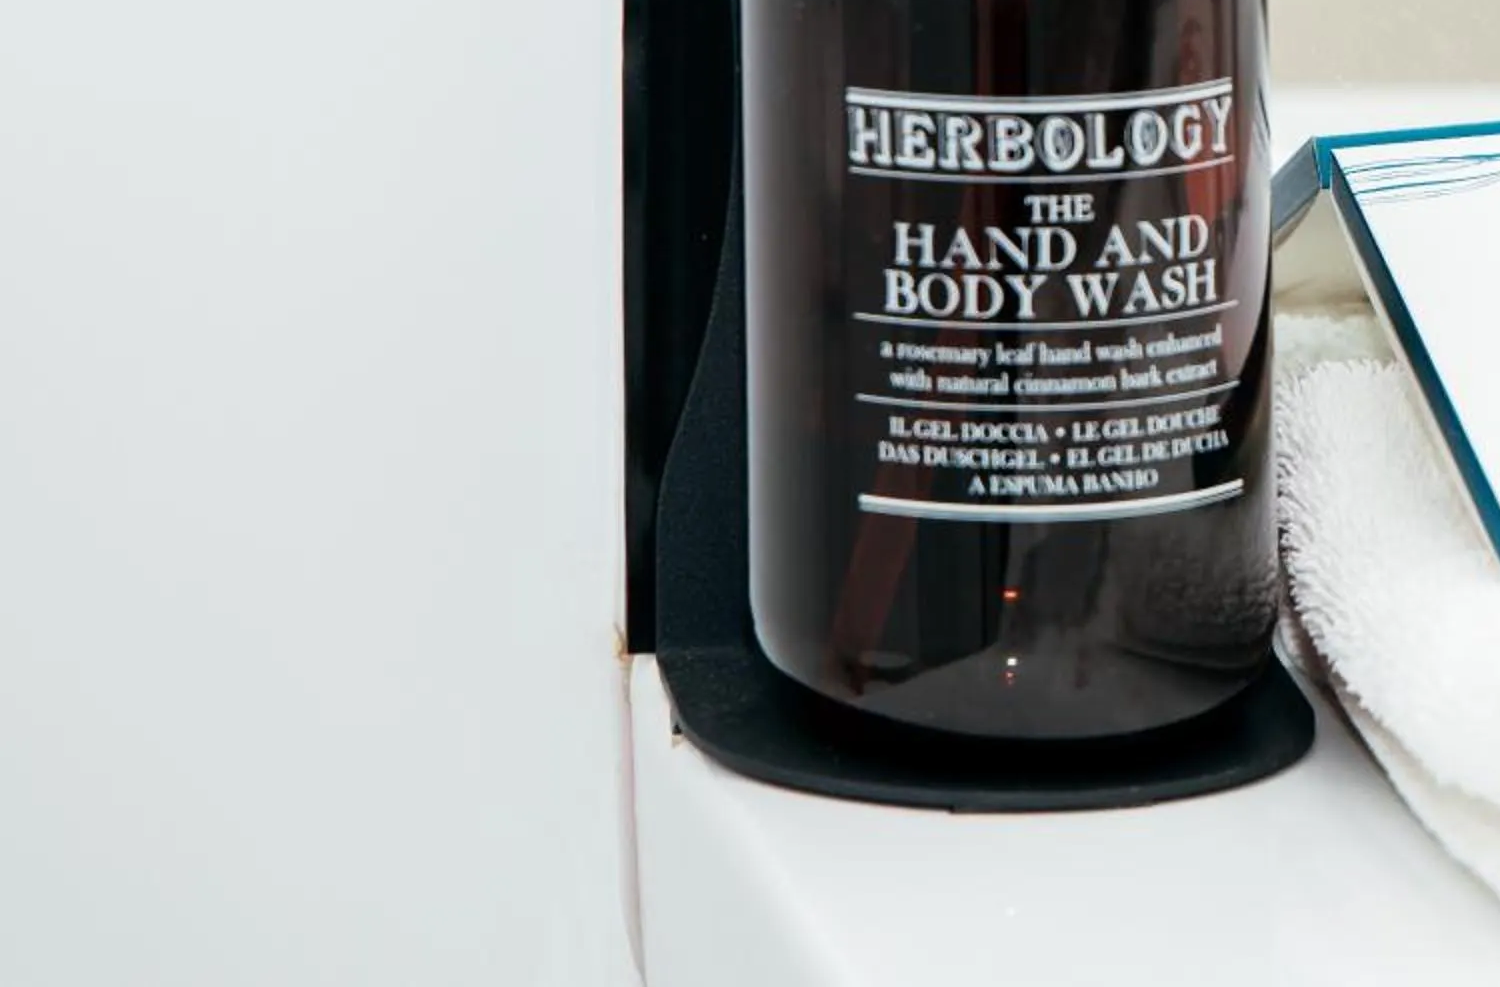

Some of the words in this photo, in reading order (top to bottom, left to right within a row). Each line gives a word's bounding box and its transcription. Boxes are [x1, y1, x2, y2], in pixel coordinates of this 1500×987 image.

[847, 96, 1232, 173] HERBOLOGY
[1024, 193, 1095, 224] THE
[893, 221, 1077, 270] HAND
[1094, 213, 1209, 268] AND
[884, 268, 1046, 319] BODY
[1066, 259, 1217, 318] WASH
[880, 341, 893, 358] a
[896, 342, 992, 369] rosemary
[995, 341, 1035, 366] leaf
[1038, 340, 1092, 365] hand
[1095, 336, 1143, 362] wash
[1146, 322, 1222, 358] enhanced
[889, 366, 933, 392] with
[936, 374, 1009, 396] natural
[1013, 371, 1117, 396] cinnamon
[1120, 367, 1164, 391] bark
[1165, 358, 1217, 386] extract
[889, 415, 912, 438] IL
[912, 418, 959, 442] GEL
[961, 421, 1048, 445] DOCCIA
[1072, 421, 1100, 443] LE
[1101, 417, 1146, 439] GEL
[1146, 404, 1221, 436] DOUCHE
[878, 440, 921, 465] DAS
[922, 444, 1045, 471] DUSCHGEL
[1066, 447, 1096, 469] EL
[1097, 443, 1141, 467] GEL
[1141, 439, 1171, 463] DE
[1171, 428, 1229, 459] DUCHA
[968, 473, 986, 497] A
[989, 471, 1079, 498] ESPUMA
[1082, 467, 1160, 495] BANHO
